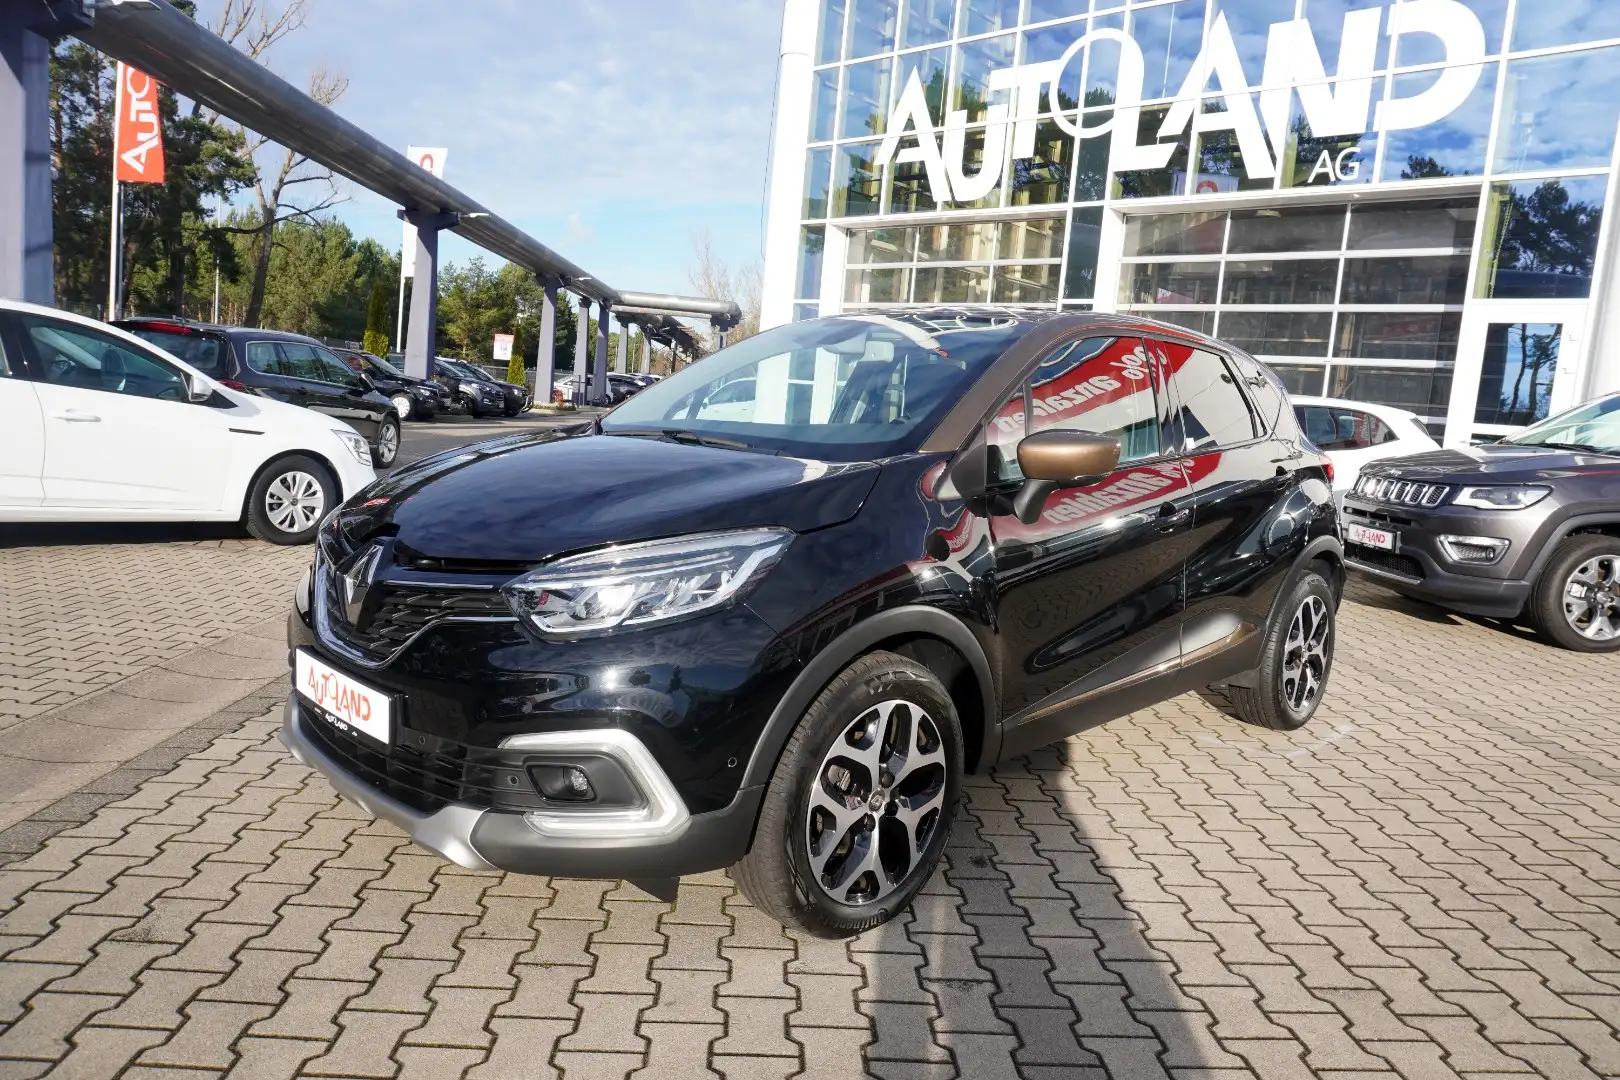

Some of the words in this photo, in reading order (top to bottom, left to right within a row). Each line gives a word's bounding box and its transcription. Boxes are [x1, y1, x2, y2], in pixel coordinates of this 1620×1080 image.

[874, 0, 1487, 202] AUTOLAND
[1307, 147, 1362, 183] AG
[308, 665, 371, 722] AUTOLAND
